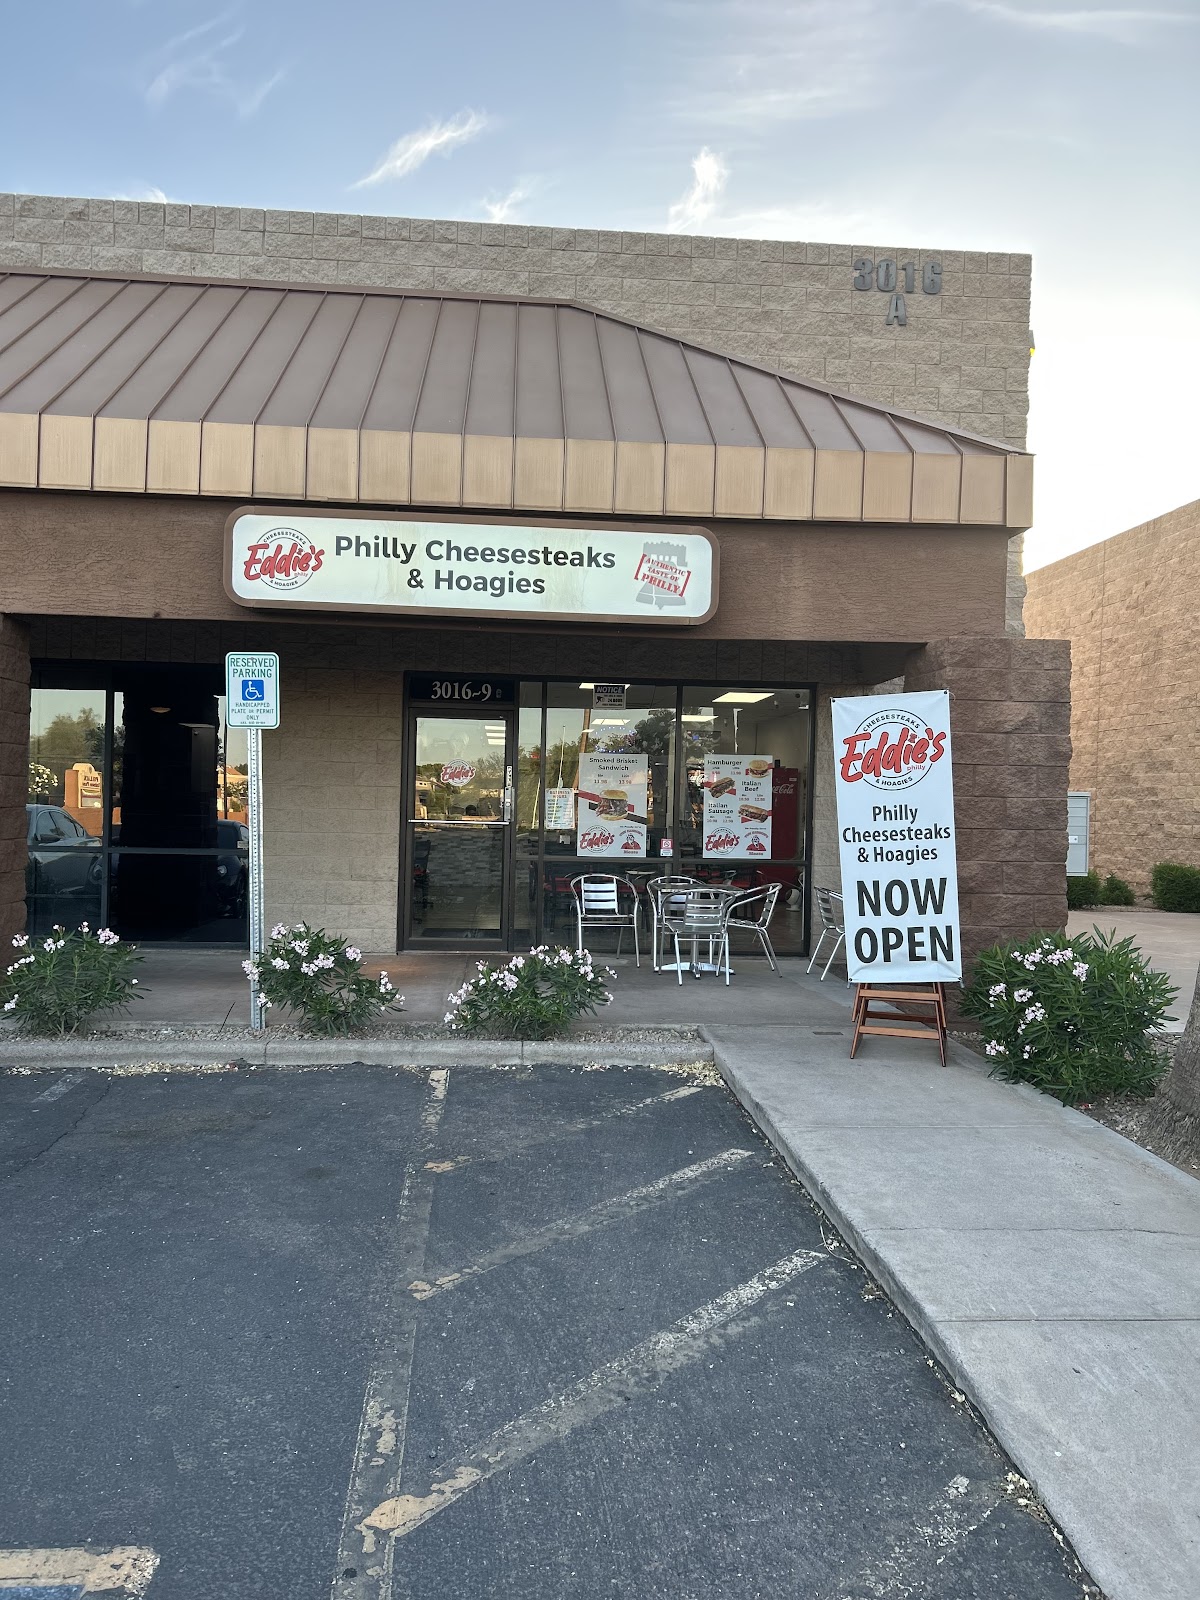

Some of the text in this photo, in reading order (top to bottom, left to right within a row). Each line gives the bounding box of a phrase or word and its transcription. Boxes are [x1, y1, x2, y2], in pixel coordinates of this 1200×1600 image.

[853, 258, 943, 295] 3016
[885, 293, 908, 326] A
[263, 531, 306, 545] CHEESESTEAKS
[244, 543, 325, 581] Eddie's
[335, 535, 616, 569] Philly Cheesesteaks
[646, 557, 686, 577] AUTHENTIC
[647, 566, 669, 579] TASTE
[407, 568, 546, 597] & Hoagies
[641, 573, 681, 593] PHILLY
[230, 657, 274, 668] RESERVED
[232, 668, 272, 678] PARKING
[862, 714, 920, 732] CHEESESTEAKS
[840, 727, 947, 783] Eddie's
[441, 765, 475, 781] Eddie's
[881, 776, 913, 787] HOAGIES
[872, 804, 918, 824] Philly
[579, 832, 615, 849] Eddie's
[704, 832, 740, 851] Eddie's
[842, 823, 951, 843] Cheesesteaks
[857, 845, 938, 865] & Hoagies
[856, 877, 947, 917] NOW
[854, 925, 954, 964] OPEN
